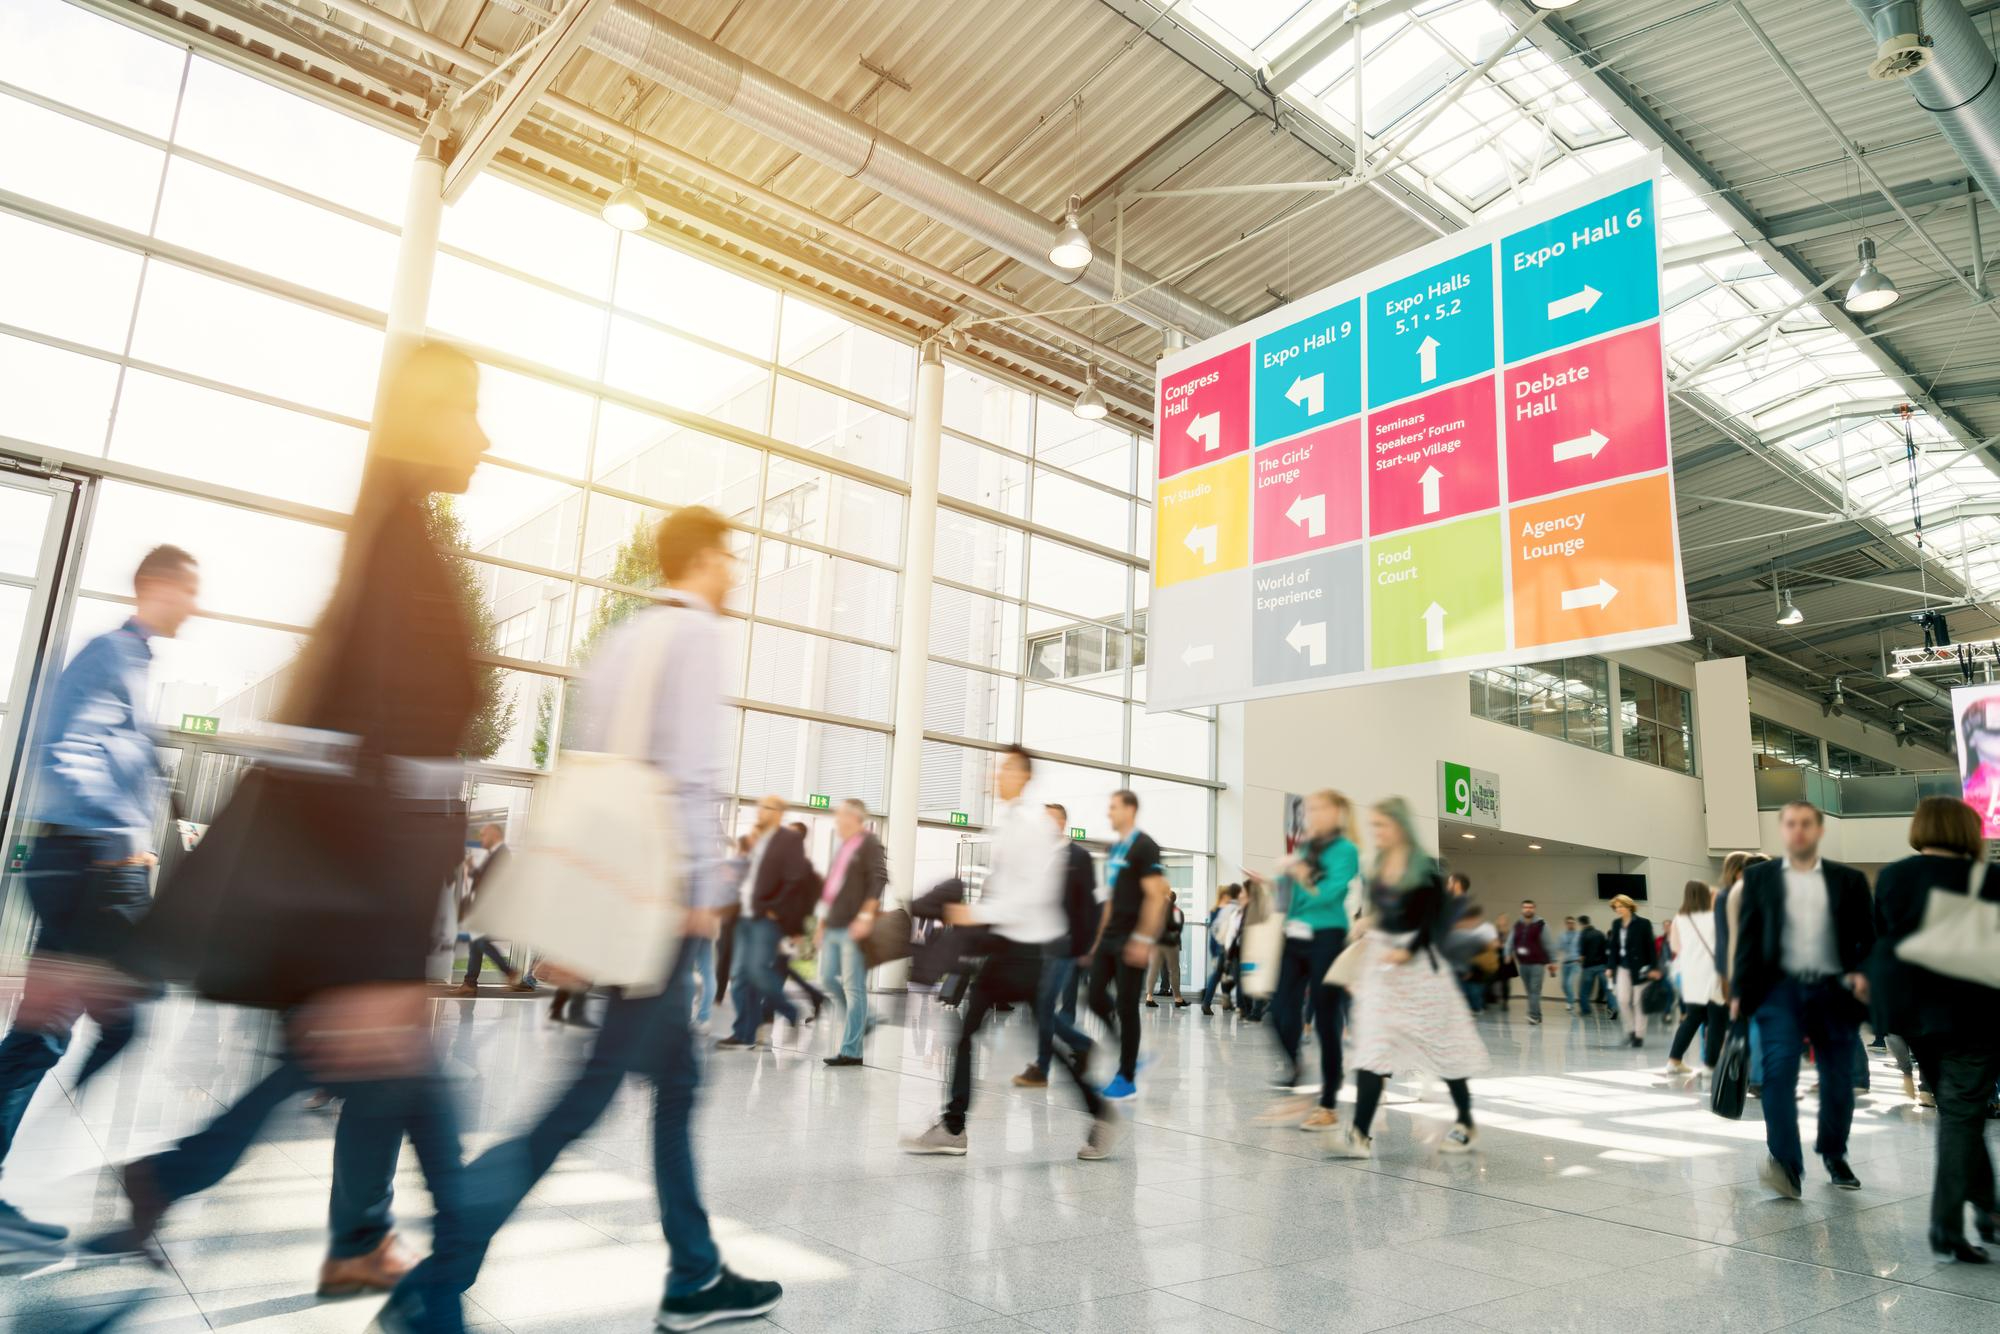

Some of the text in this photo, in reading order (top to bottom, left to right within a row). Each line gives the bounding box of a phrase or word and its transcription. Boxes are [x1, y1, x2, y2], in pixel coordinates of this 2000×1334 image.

[1514, 207, 1642, 272] Expo Hall 6
[1386, 273, 1471, 316] Expo Halls
[1395, 299, 1461, 335] 5.1 5.2
[1263, 321, 1352, 368] Expo Hall 9
[1165, 371, 1219, 400] Congress
[1516, 366, 1590, 399] Debate
[1165, 396, 1188, 418] Hall
[1516, 393, 1558, 421] Hall
[1375, 413, 1425, 436] Seminars
[1428, 420, 1465, 438] Forum
[1258, 458, 1279, 473] The
[1376, 439, 1461, 471] Start-up Village
[1258, 468, 1300, 489] Lounge
[1163, 483, 1212, 508] TV Studio
[1521, 513, 1585, 538] Agency
[1378, 544, 1412, 567] Food
[1523, 538, 1584, 560] Lounge
[1257, 568, 1311, 592] World of
[1378, 566, 1418, 585] Court
[1256, 587, 1323, 612] Experience
[1455, 778, 1470, 816] 9
